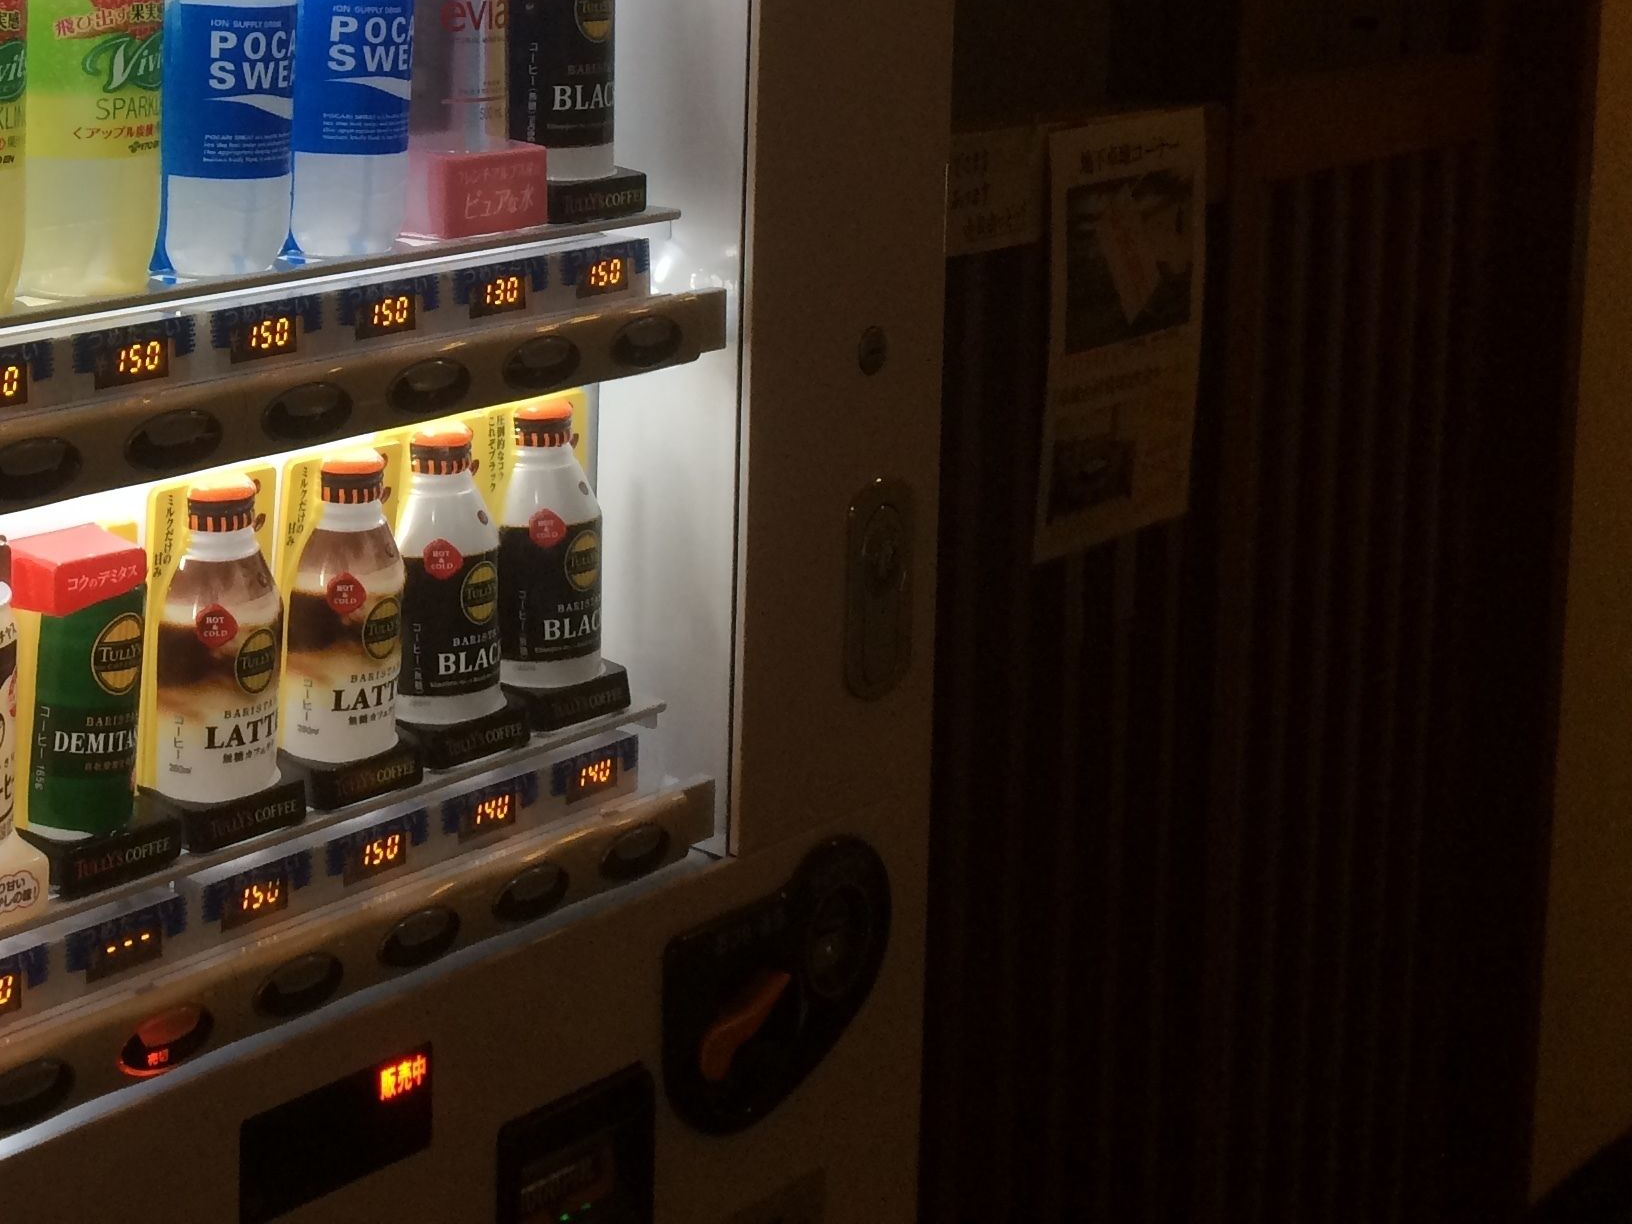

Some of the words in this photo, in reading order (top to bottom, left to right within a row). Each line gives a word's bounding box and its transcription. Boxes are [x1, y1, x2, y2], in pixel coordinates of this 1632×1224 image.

[552, 84, 614, 112] BLAC
[588, 257, 623, 288] 150
[485, 275, 521, 307] 130
[372, 295, 410, 329] 150
[248, 316, 290, 351] 150
[115, 339, 162, 376] 150
[285, 521, 297, 548] 甘み
[66, 563, 139, 592] コクのデミタス
[152, 551, 164, 579] 甘み
[332, 594, 358, 607] COLD
[335, 583, 355, 593] HOT
[203, 628, 228, 638] COLD
[205, 615, 225, 625] HOT
[542, 607, 602, 642] BLAC
[436, 649, 501, 677] BLAC
[331, 678, 400, 713] LATT
[484, 722, 524, 745] COFFEE
[376, 760, 417, 782] COFFEE
[254, 798, 298, 824] COFFEE
[124, 836, 170, 864] COFFEE
[363, 833, 401, 867] 150
[240, 879, 281, 913] 150
[378, 1053, 429, 1104] 販売中
